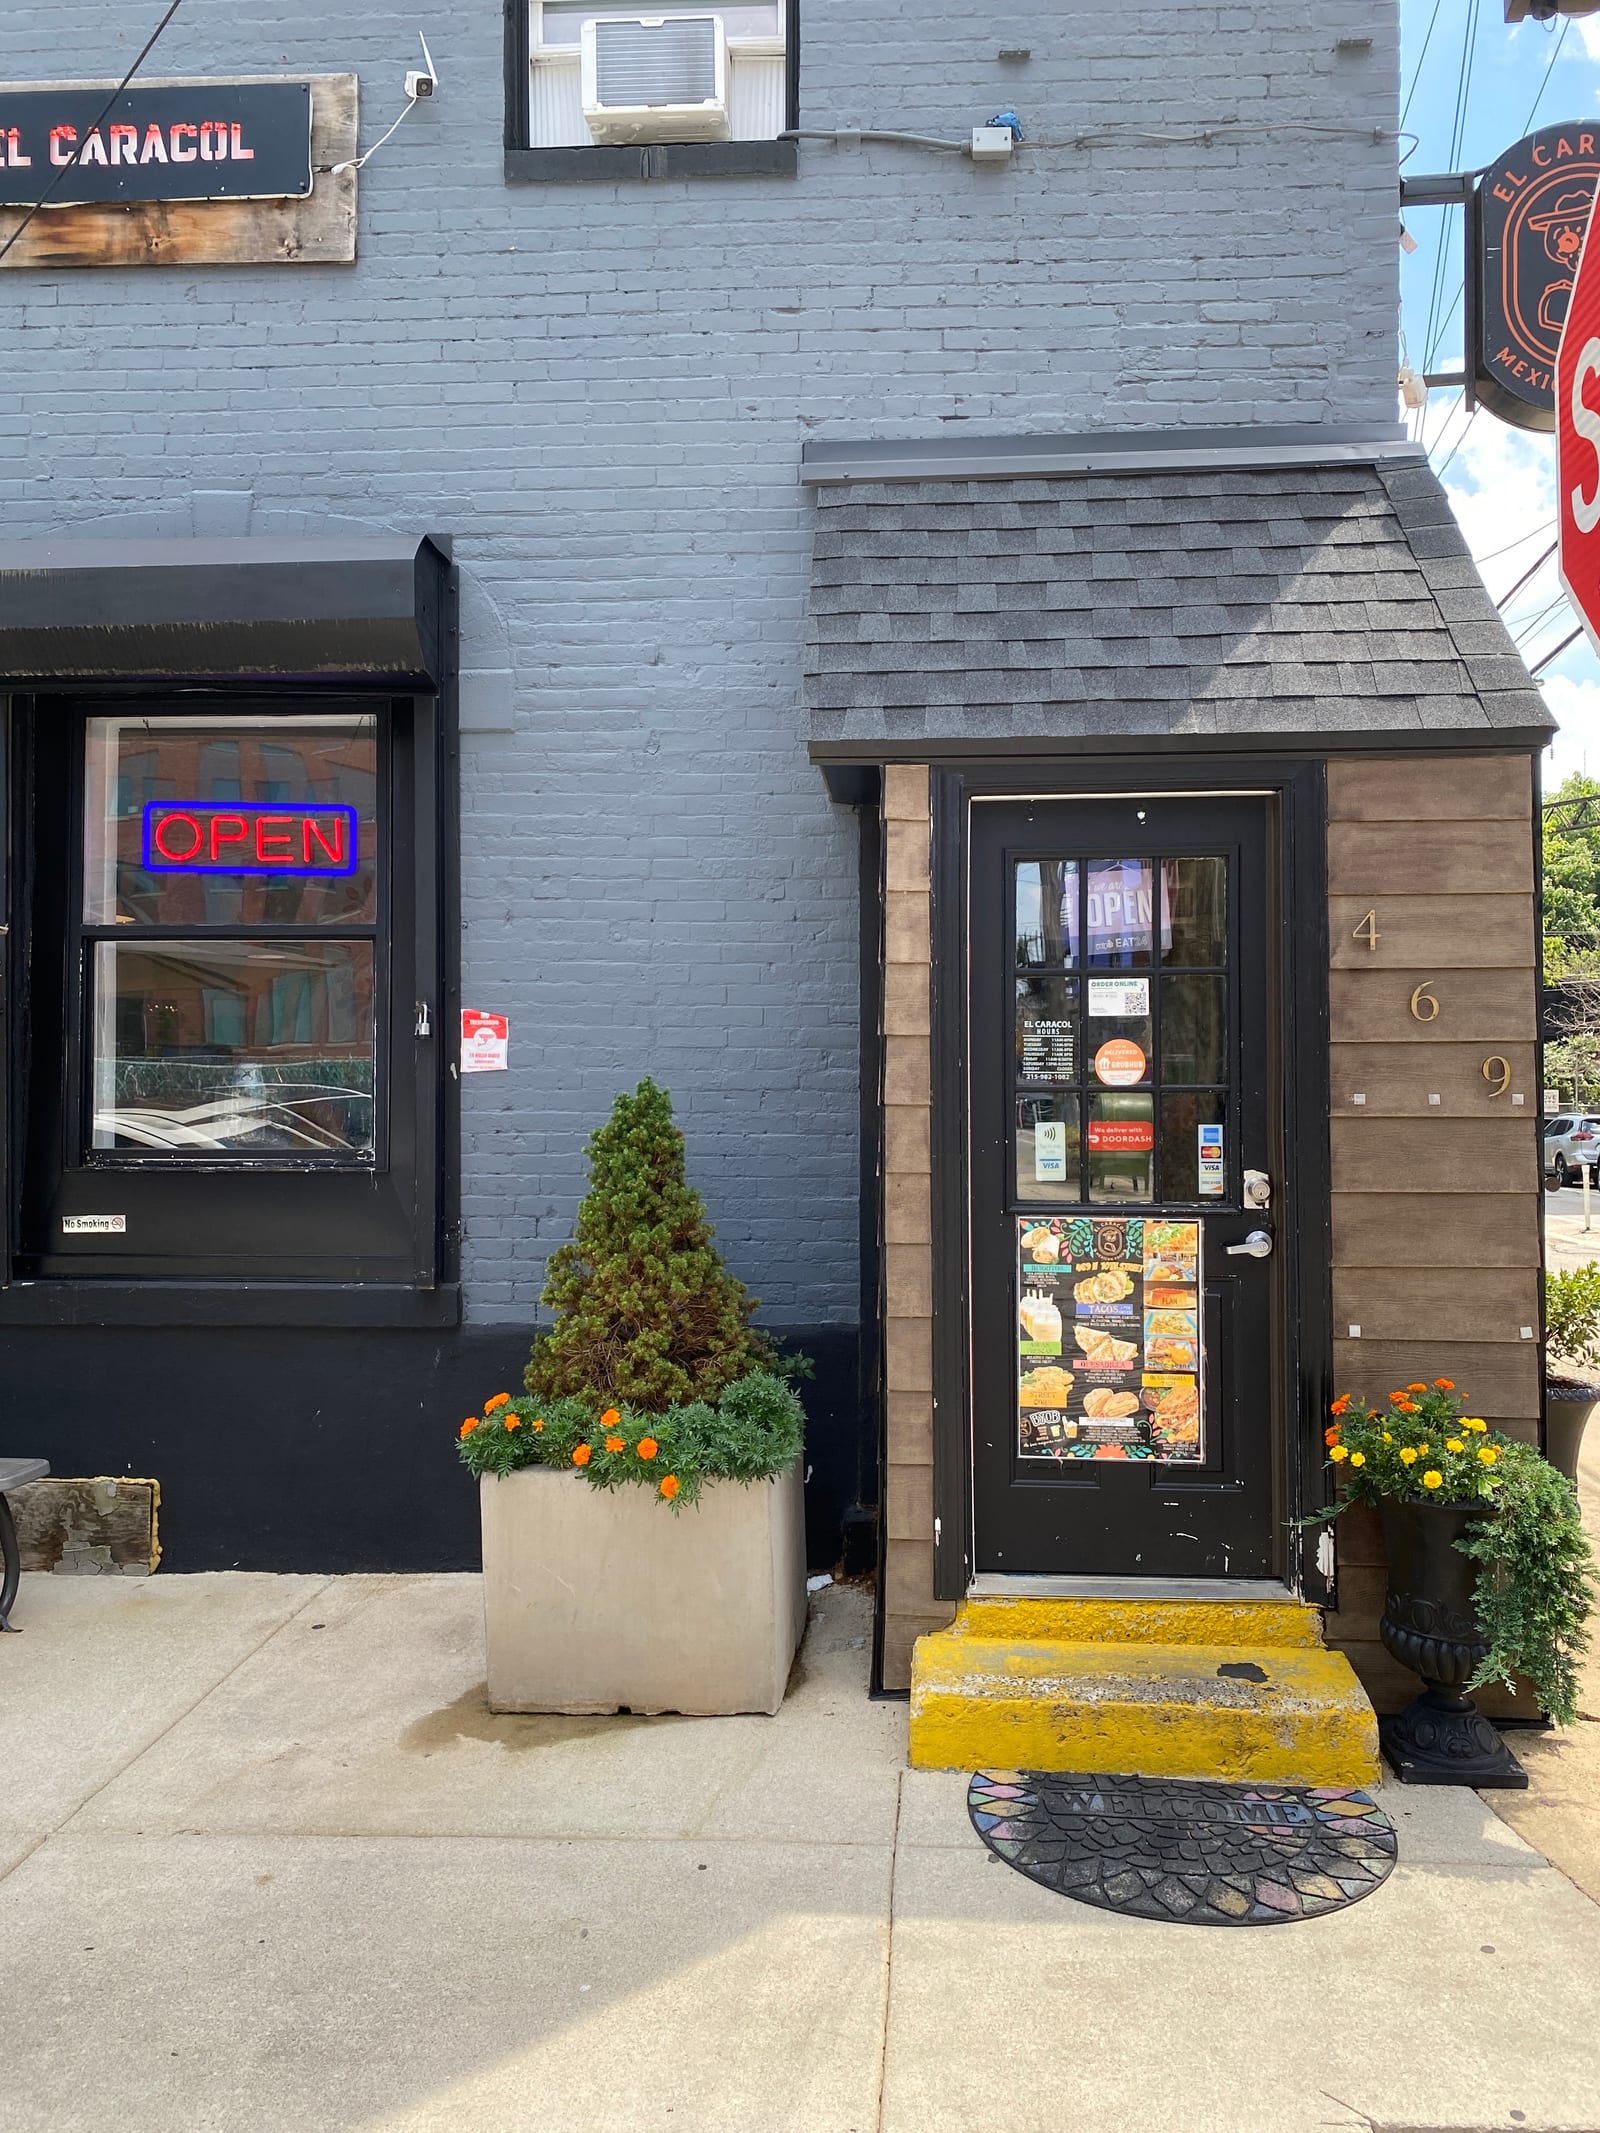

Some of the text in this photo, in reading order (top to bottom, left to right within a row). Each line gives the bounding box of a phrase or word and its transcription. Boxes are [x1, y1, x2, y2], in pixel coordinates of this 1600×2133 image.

[50, 121, 255, 166] CARACOL
[1492, 171, 1528, 203] EL
[154, 812, 344, 864] OPEN
[1088, 888, 1152, 928] OPEN
[1352, 909, 1382, 951] 4
[1091, 980, 1113, 988] ORDER
[1410, 980, 1440, 1022] 6
[1023, 1020, 1073, 1028] EL CARACOL
[1482, 1056, 1511, 1098] 9
[1102, 1135, 1152, 1143] DOORDASH
[64, 1218, 110, 1231] No Smoking
[1088, 1302, 1119, 1314] TACOS
[1030, 1410, 1060, 1427] BYOB
[1062, 1792, 1316, 1826] WELCOME
